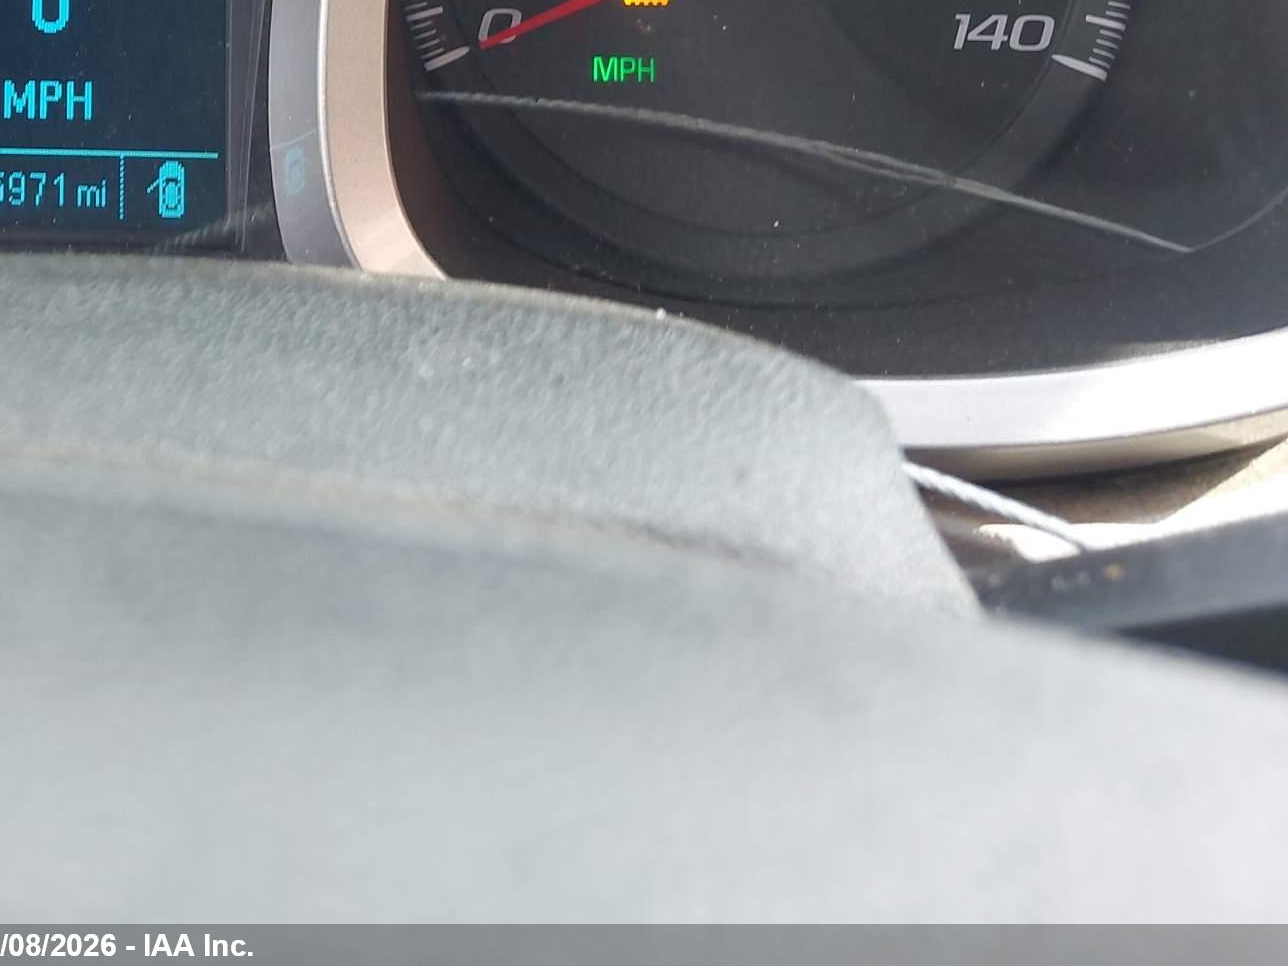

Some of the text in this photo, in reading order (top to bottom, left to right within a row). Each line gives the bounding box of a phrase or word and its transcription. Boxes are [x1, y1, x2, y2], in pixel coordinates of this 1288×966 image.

[478, 8, 523, 44] 0
[952, 14, 1056, 51] 140
[592, 56, 656, 83] MPH
[3, 80, 93, 121] MPH
[76, 179, 107, 208] mi
